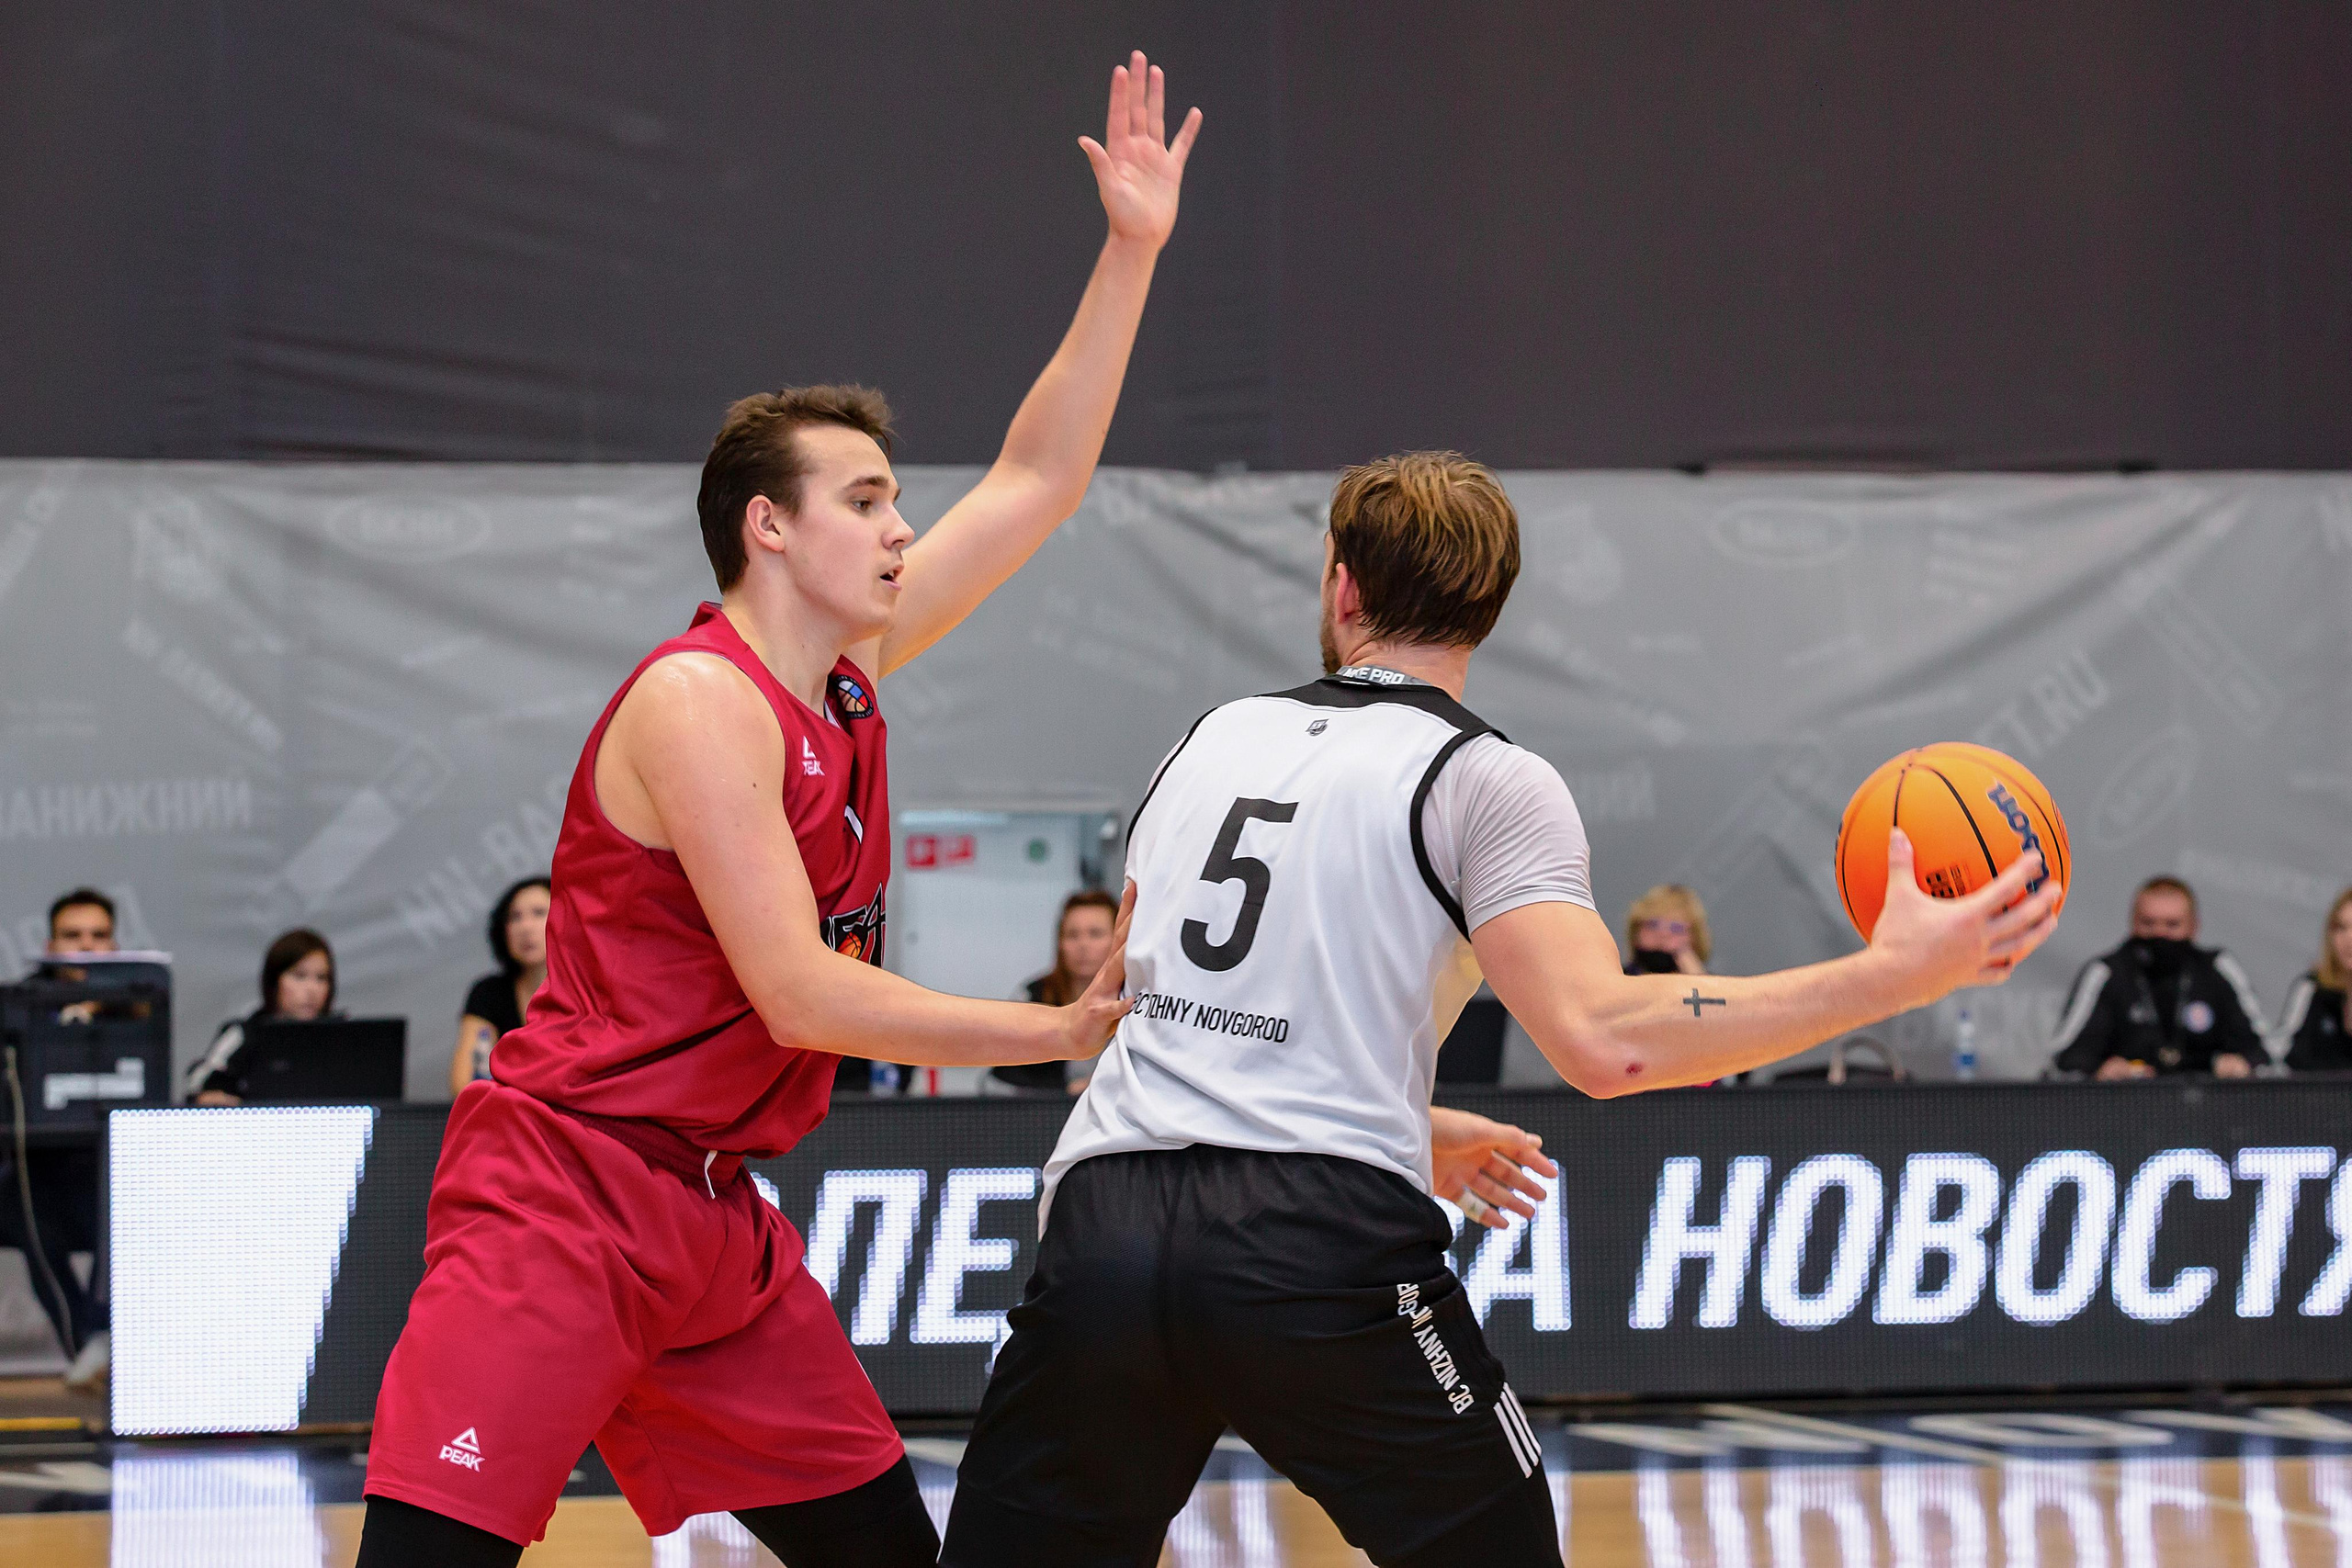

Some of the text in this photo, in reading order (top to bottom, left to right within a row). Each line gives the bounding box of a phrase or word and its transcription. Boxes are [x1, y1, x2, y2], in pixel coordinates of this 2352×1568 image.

[1368, 668, 1406, 685] PRO
[0, 770, 252, 840] АНИЖНИЙ
[1181, 796, 1298, 972] 5
[1127, 992, 1149, 1015] C
[1193, 1004, 1290, 1043] NOVGOROD
[1413, 1325, 1461, 1392] NIZHNY
[1448, 1384, 1475, 1415] BC
[438, 1444, 486, 1472] PEAK
